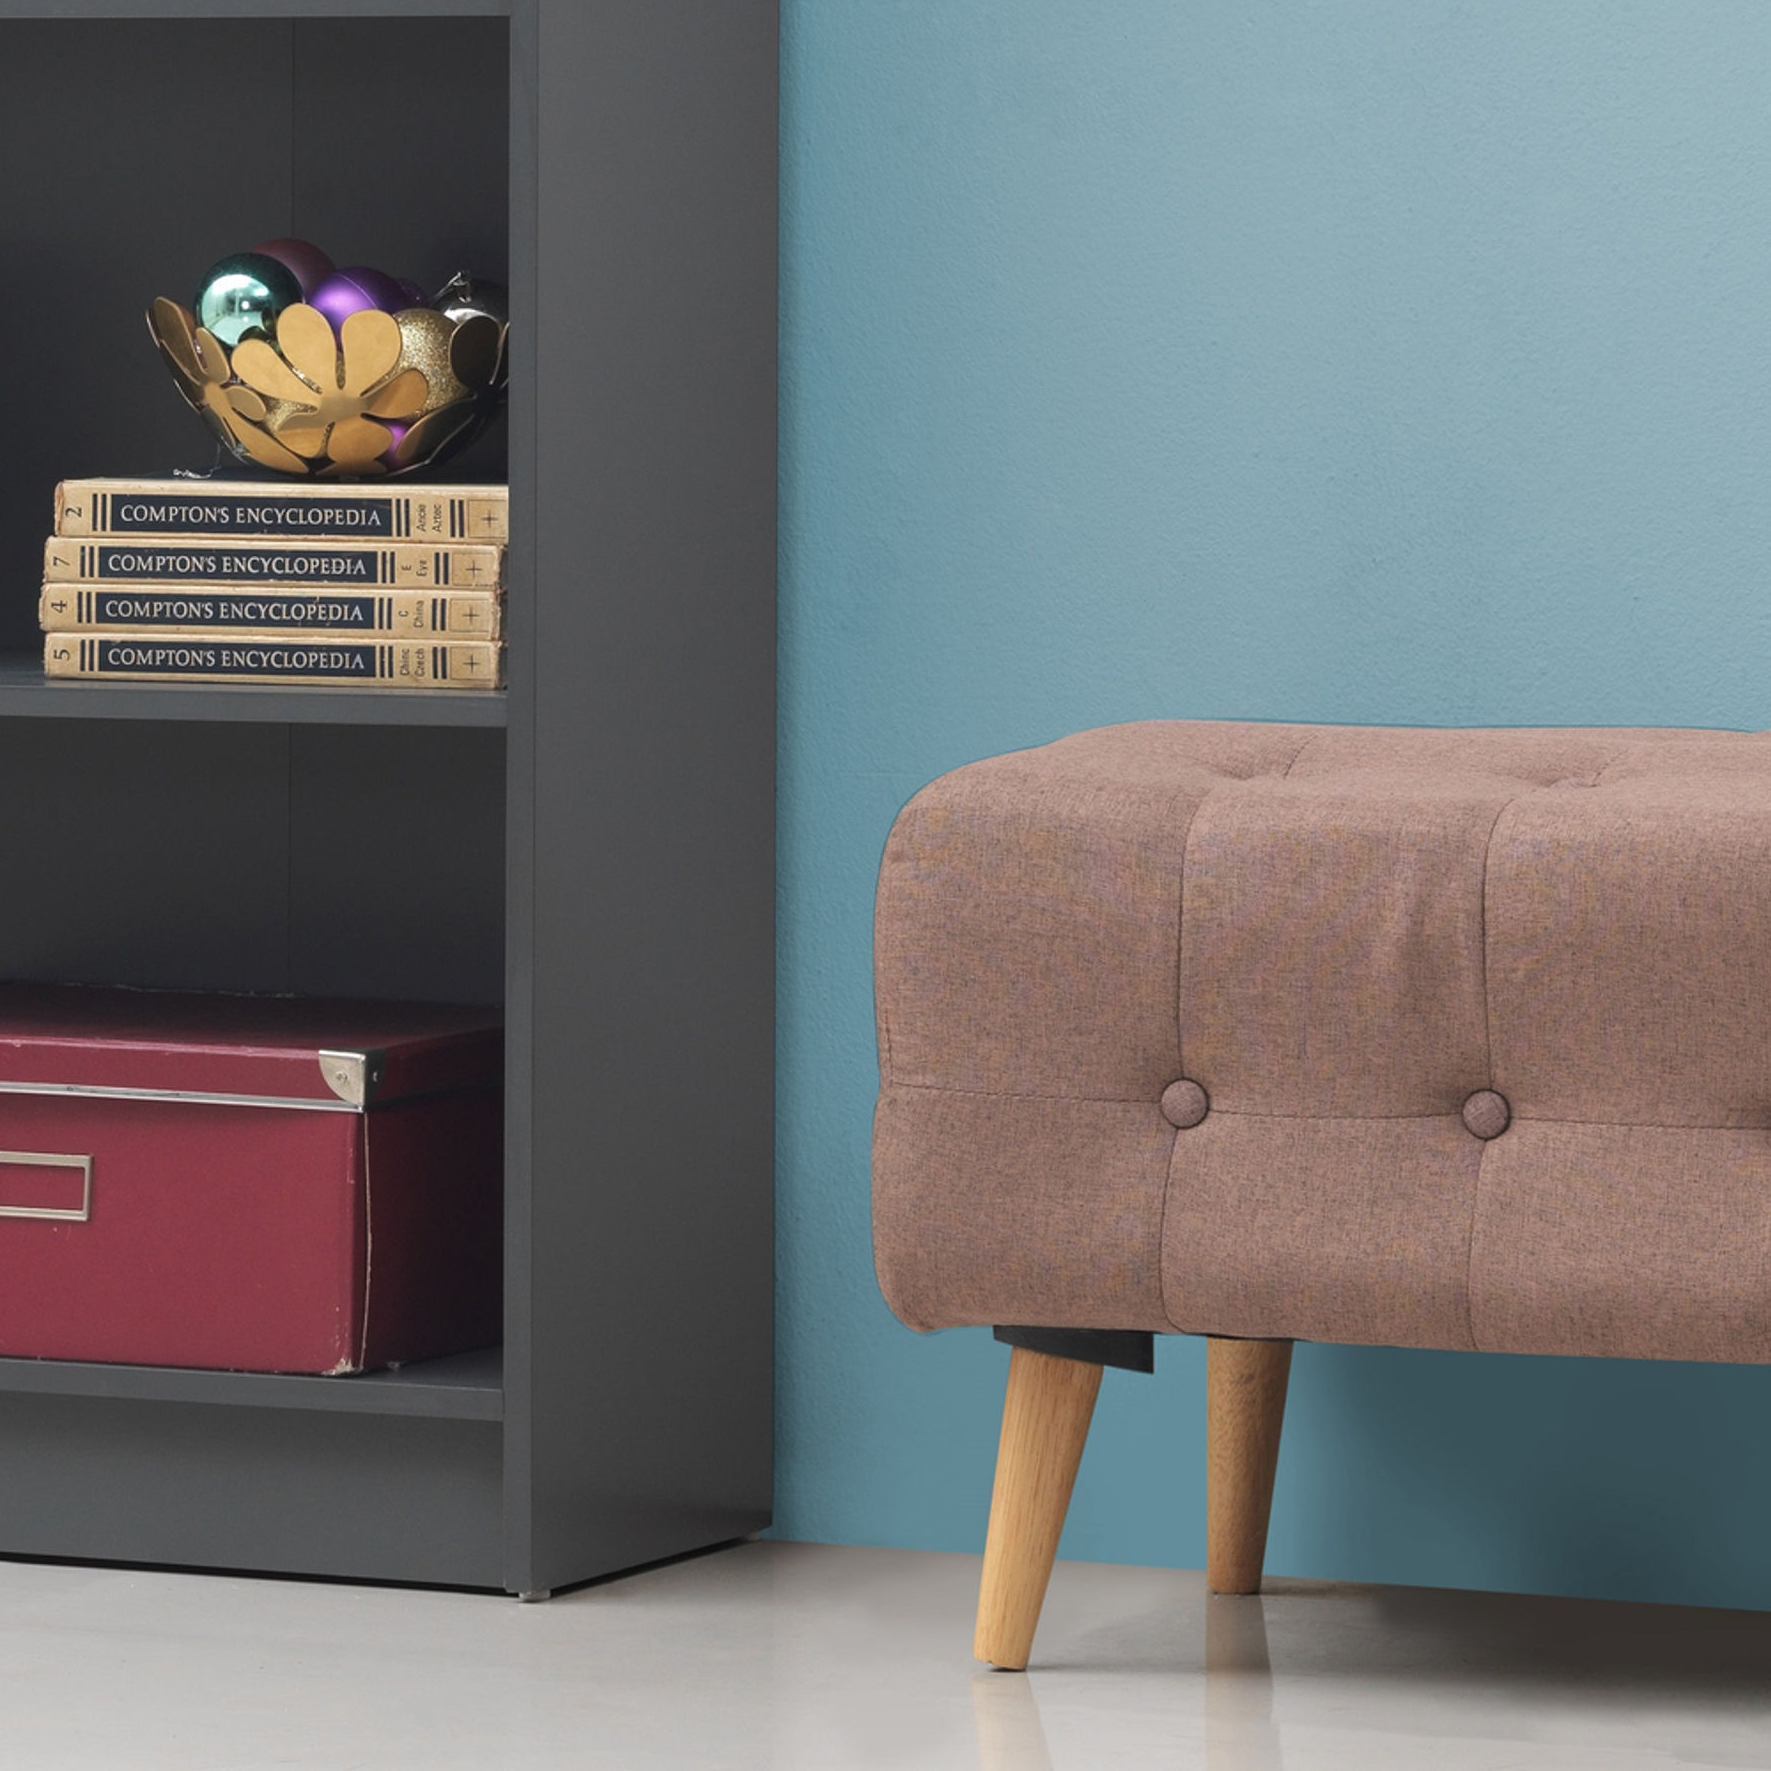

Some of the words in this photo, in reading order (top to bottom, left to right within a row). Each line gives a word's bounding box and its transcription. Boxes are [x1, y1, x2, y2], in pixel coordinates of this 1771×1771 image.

[65, 506, 82, 518] 2
[120, 504, 229, 523] COMPTON'S
[235, 507, 381, 526] ENCYCLOPEDIA
[431, 503, 442, 533] Aztec
[53, 556, 70, 567] 7
[108, 554, 216, 573] COMPTON'S
[222, 556, 366, 575] ENCYCLOPEDIA
[417, 559, 428, 577] Eye
[51, 600, 67, 614] 4
[105, 600, 213, 619] COMPTON'S
[219, 602, 364, 621] ENCYCLOPEDIA
[413, 600, 425, 628] China
[53, 649, 70, 660] 5
[108, 648, 215, 666] COMPTON'S
[220, 650, 365, 669] ENCYCLOPEDIA
[414, 648, 426, 677] Czech
